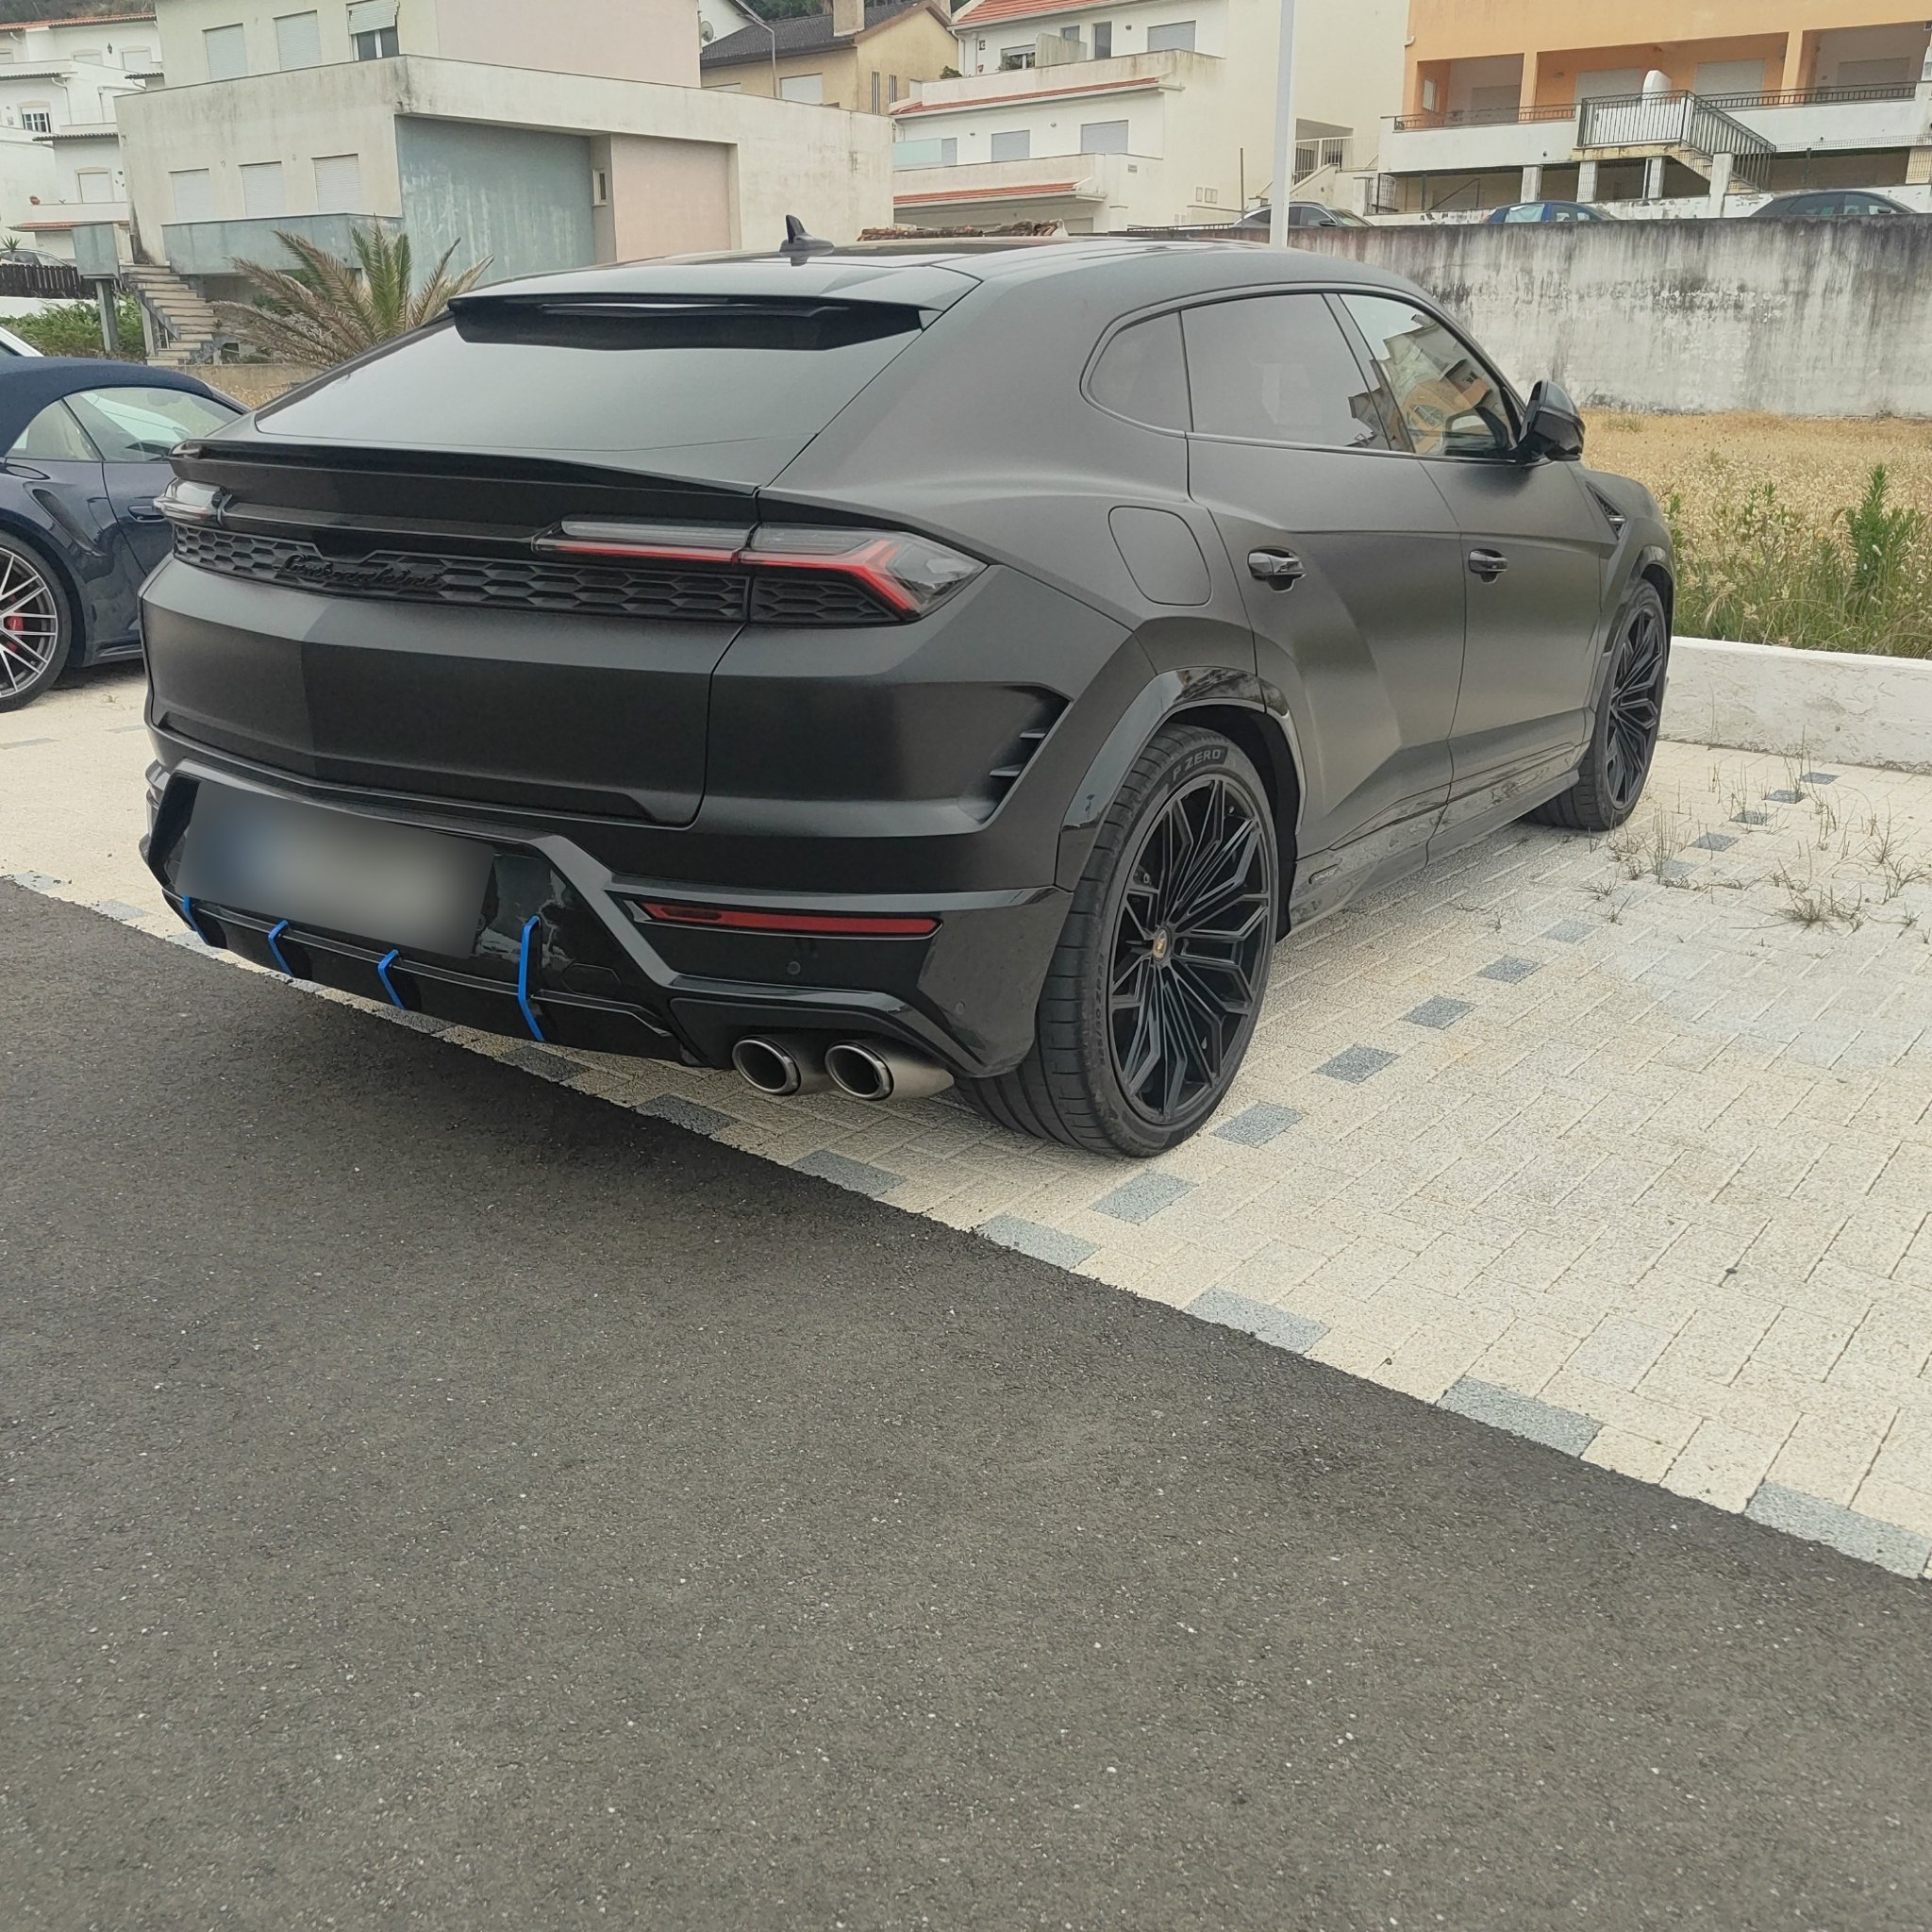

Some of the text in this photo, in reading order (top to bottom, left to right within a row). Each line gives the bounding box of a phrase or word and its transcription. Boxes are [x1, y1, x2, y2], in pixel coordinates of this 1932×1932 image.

[273, 553, 445, 590] Lamborghini
[1173, 749, 1222, 782] P ZERO
